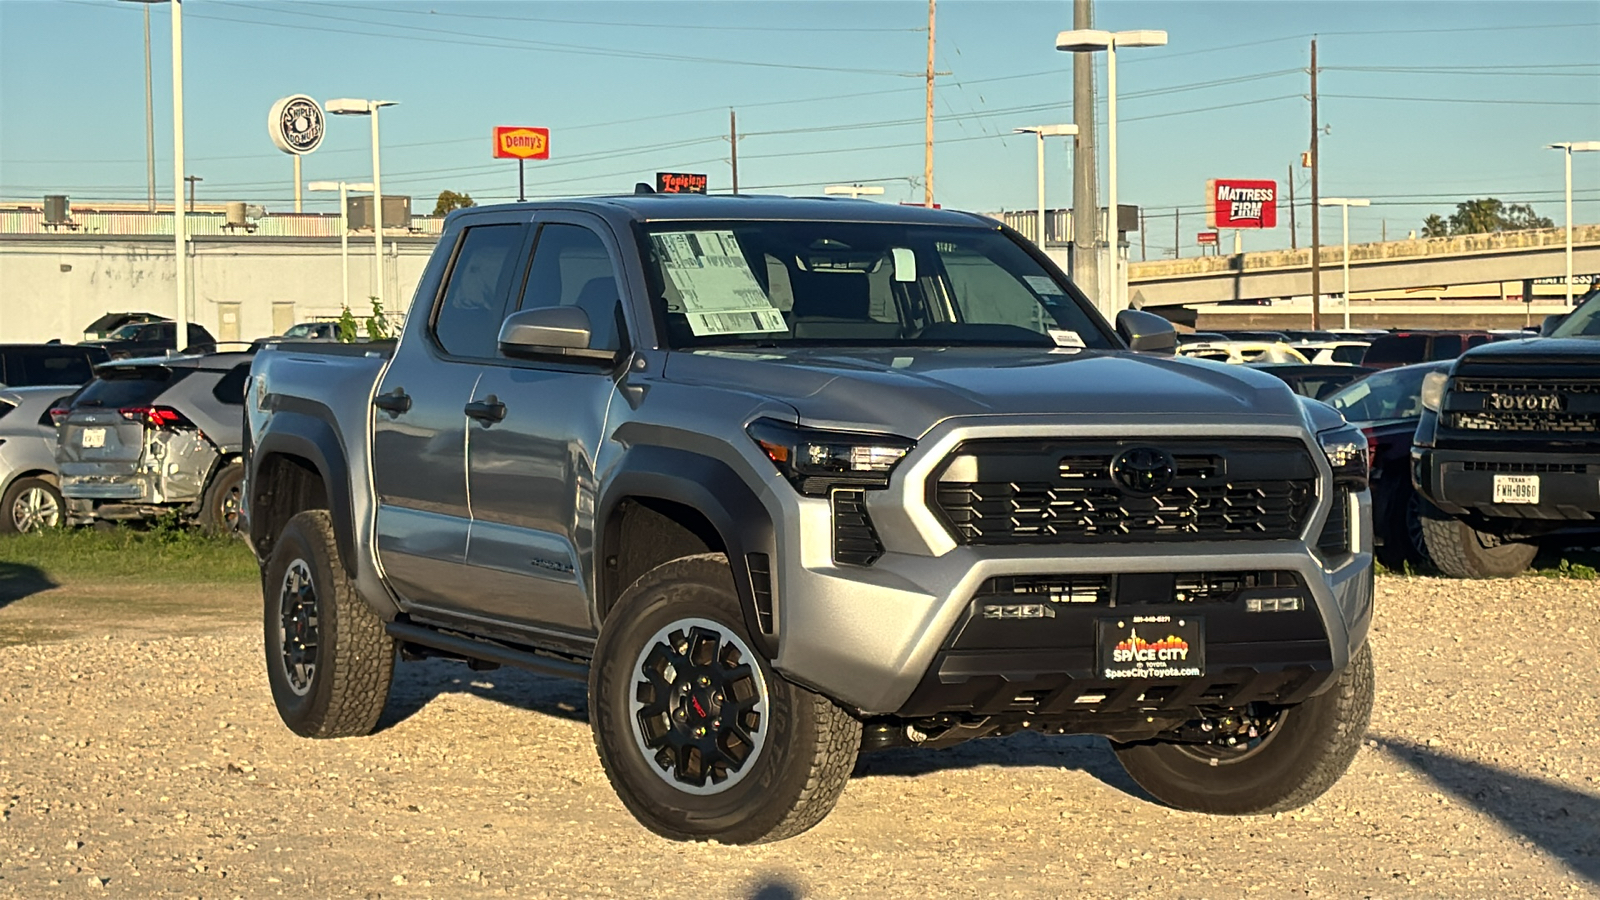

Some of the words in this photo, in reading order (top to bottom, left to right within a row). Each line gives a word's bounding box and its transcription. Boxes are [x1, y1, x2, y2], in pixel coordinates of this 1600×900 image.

[286, 107, 316, 122] SHIPLEY
[505, 135, 542, 149] Denny's
[662, 174, 706, 193] Louisiana
[1218, 186, 1273, 201] MATTRESS
[1230, 202, 1263, 217] FIRM
[1490, 393, 1561, 409] TOYOTA
[1113, 648, 1156, 662] SPACE
[1158, 647, 1189, 661] CITY
[1104, 667, 1200, 679] SpaceCityToyota.com
